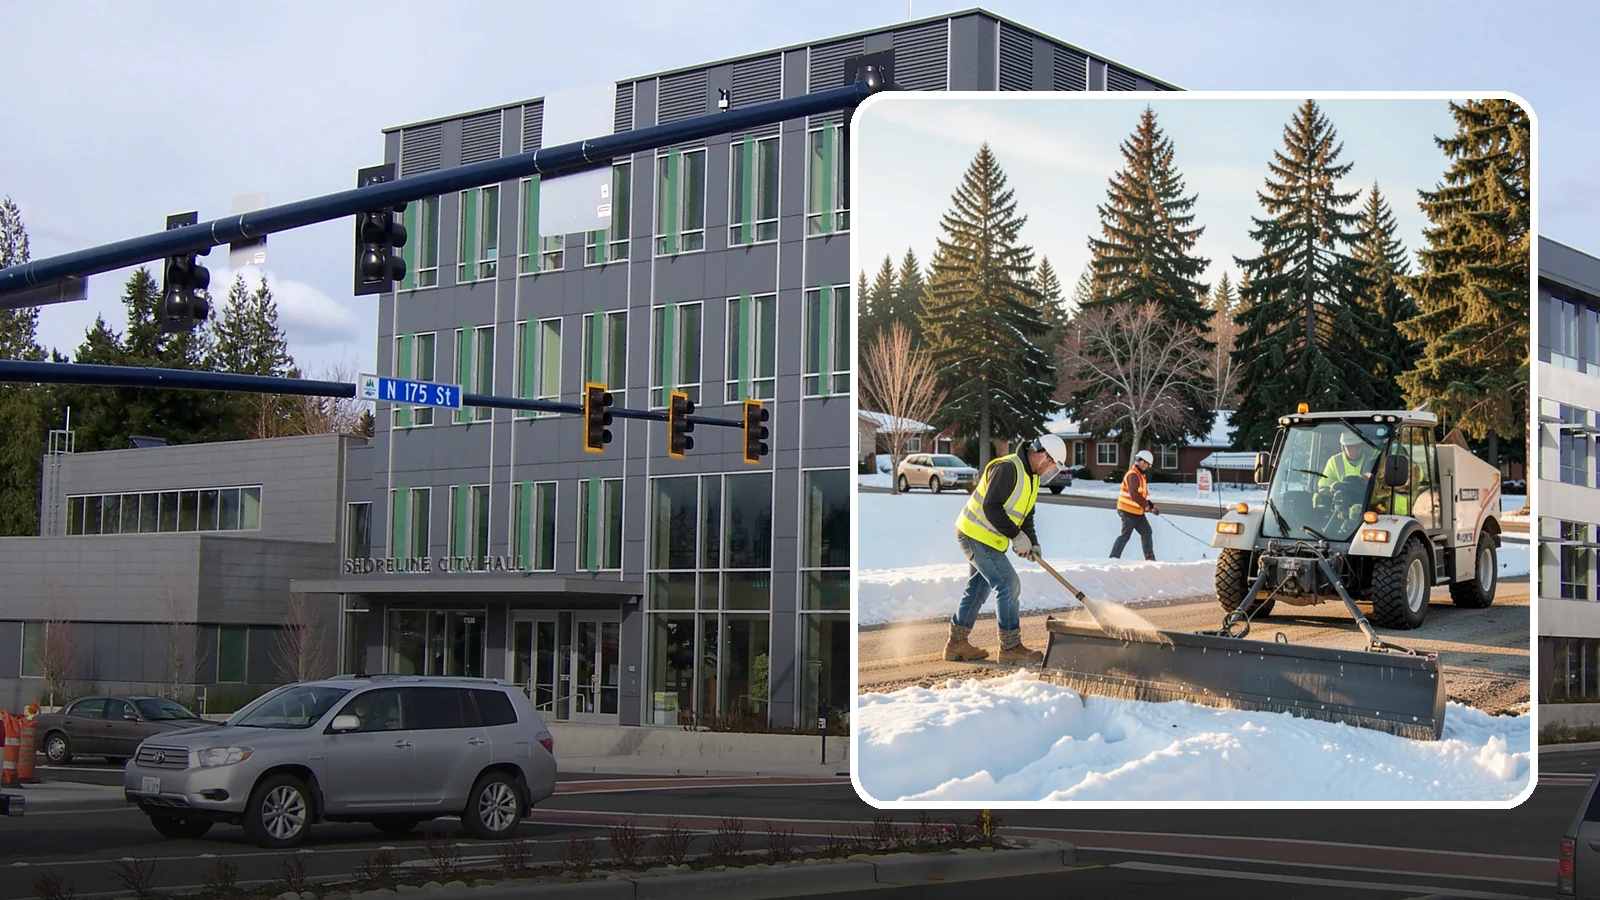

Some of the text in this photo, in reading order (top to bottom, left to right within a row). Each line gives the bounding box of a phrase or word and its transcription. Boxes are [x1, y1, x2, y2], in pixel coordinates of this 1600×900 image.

[387, 380, 451, 406] N 175 St
[344, 555, 525, 574] SHORELINE CITY HALL
